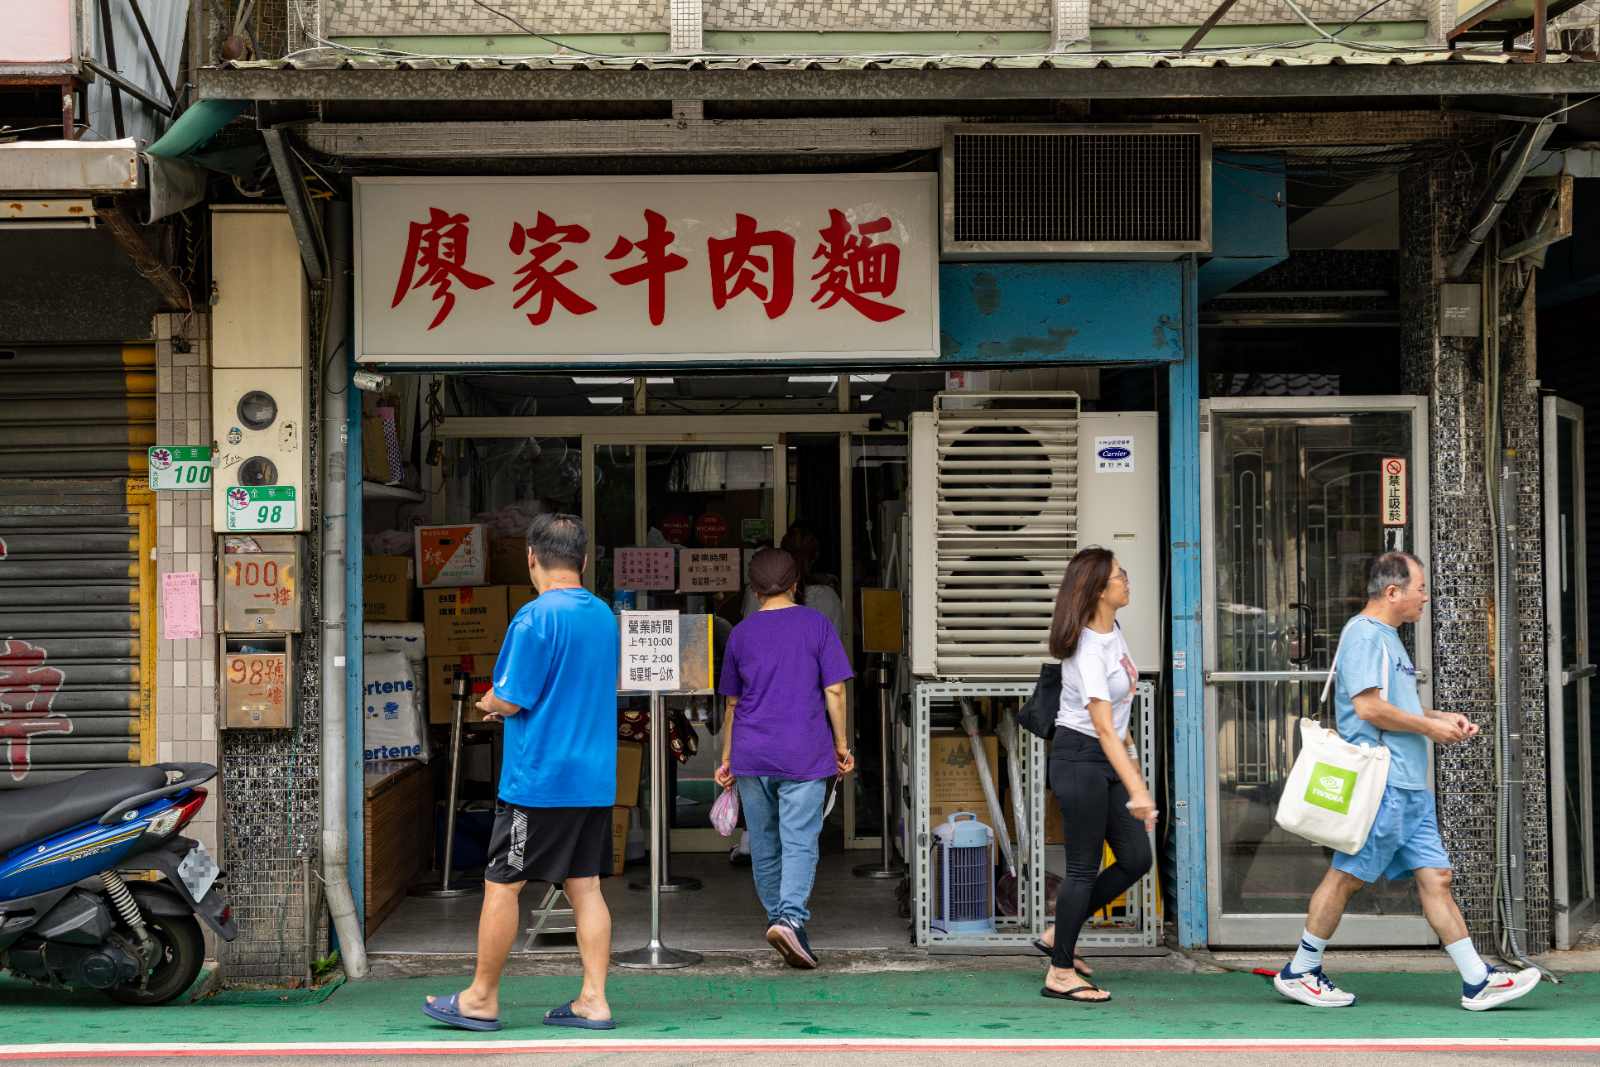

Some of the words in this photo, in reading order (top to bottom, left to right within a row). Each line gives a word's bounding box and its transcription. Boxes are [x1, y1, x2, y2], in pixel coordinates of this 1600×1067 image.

[391, 207, 906, 331] 廖家牛肉麵
[1102, 450, 1127, 458] Carrier
[174, 465, 211, 484] 100
[1388, 475, 1401, 522] 禁止吸菸
[257, 505, 282, 523] 98
[235, 560, 278, 587] 100
[628, 619, 673, 634] 營業時間
[628, 637, 673, 647] 上午10:00
[629, 654, 648, 663] 下午
[652, 654, 673, 663] 2:00
[629, 667, 674, 682] 每星期一公休
